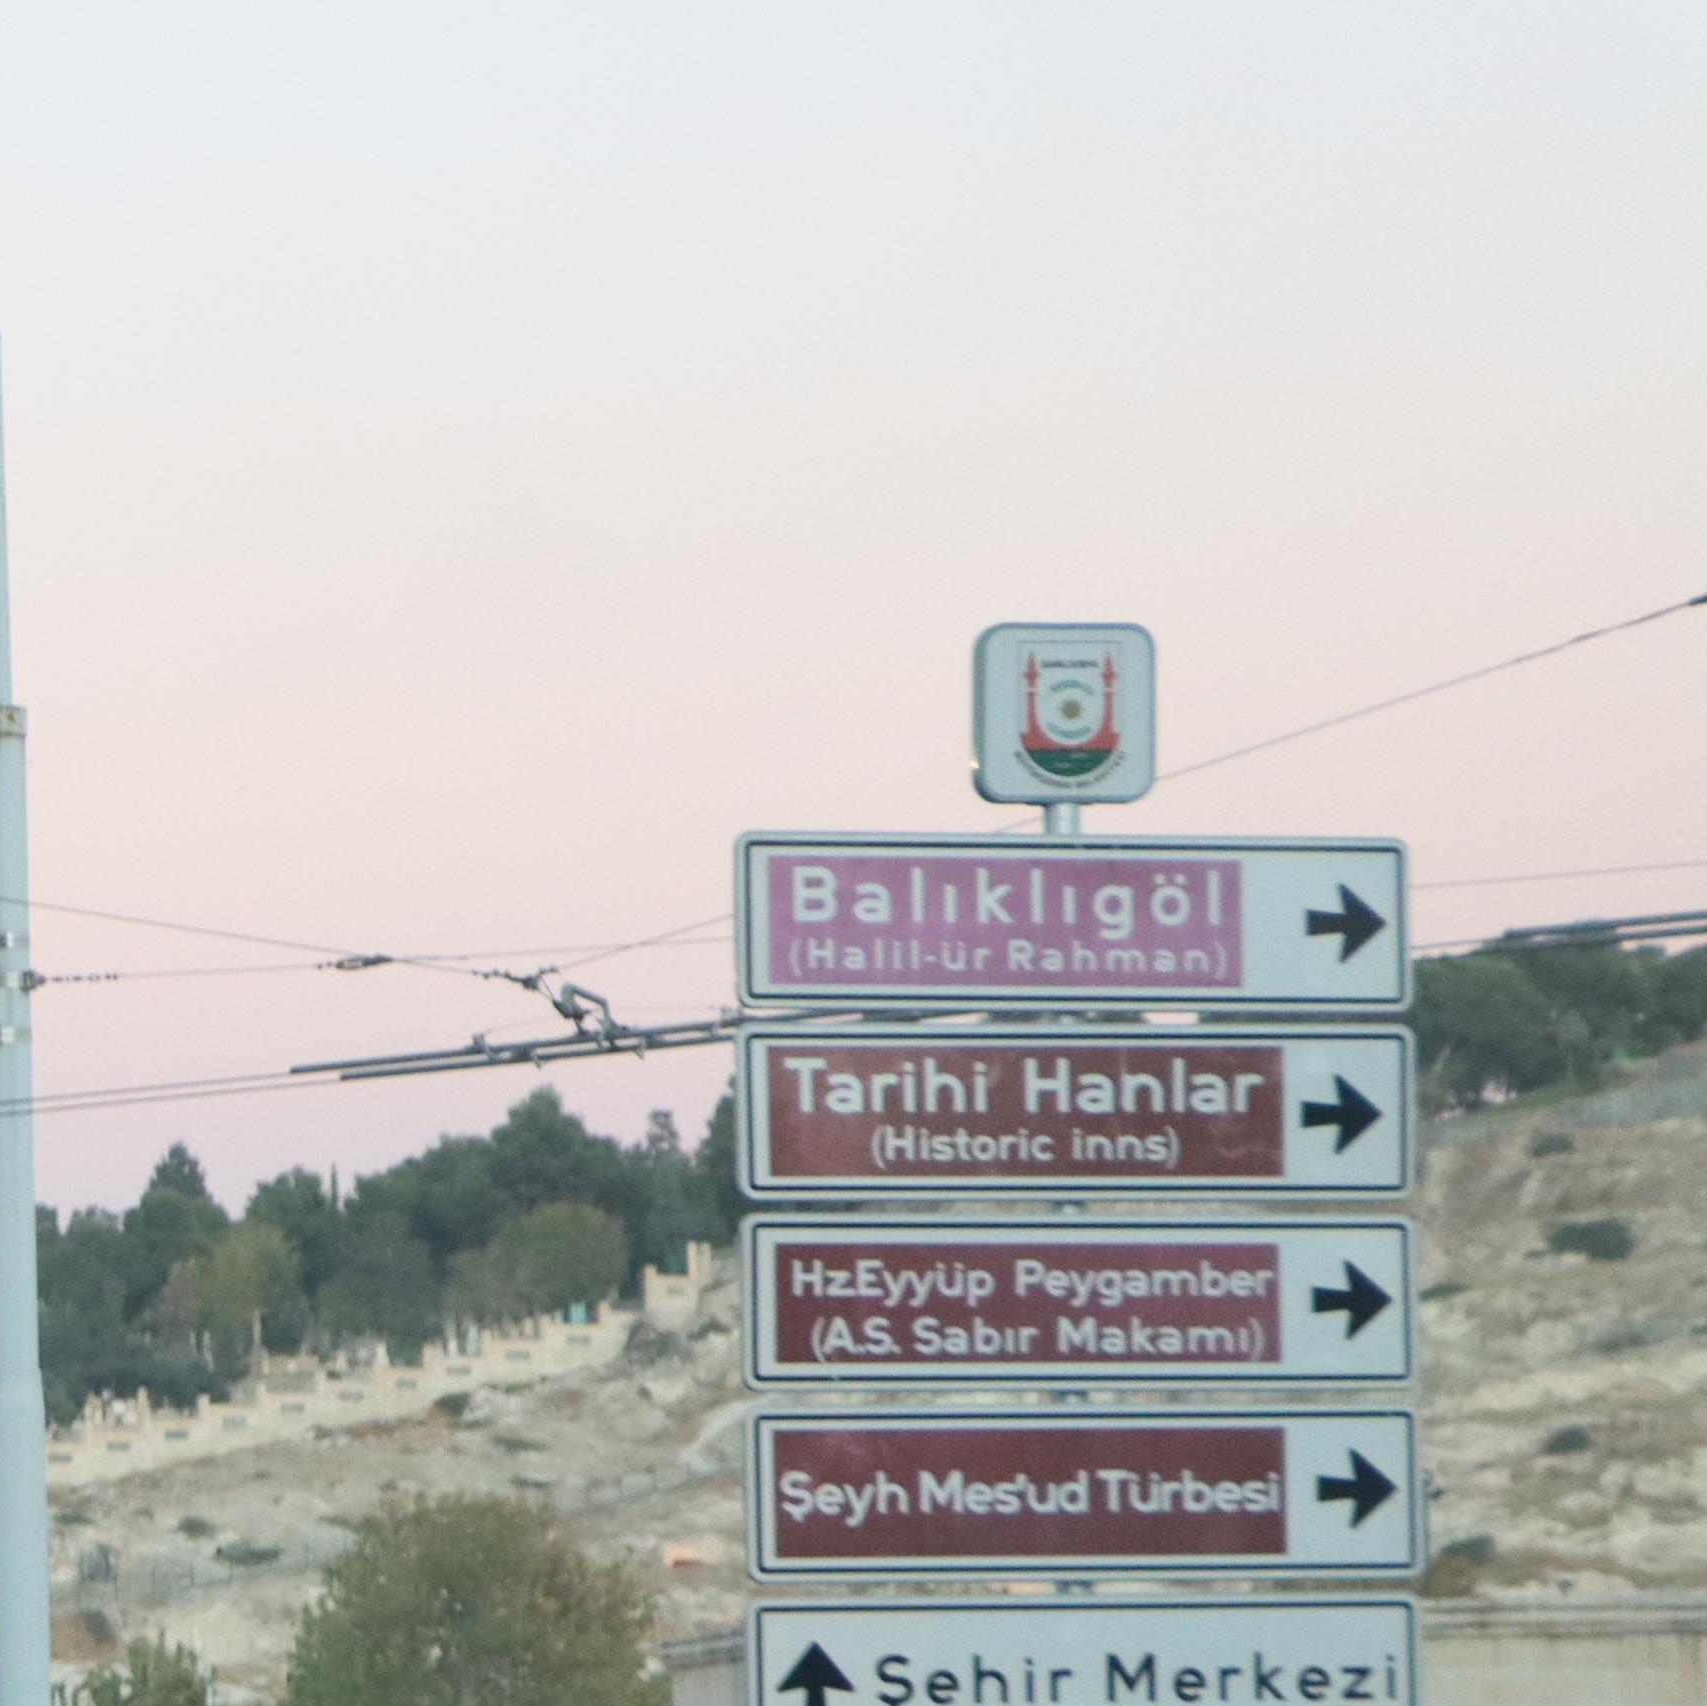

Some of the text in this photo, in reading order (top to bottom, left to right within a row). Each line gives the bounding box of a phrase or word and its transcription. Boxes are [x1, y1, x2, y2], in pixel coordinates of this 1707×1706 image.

[791, 864, 1222, 941] Balıklıgöl
[789, 937, 1228, 981] (Halil-ür Rahman)
[783, 1057, 1264, 1116] Tarihi Hanlar
[871, 1124, 1054, 1169] (Historic
[1014, 1258, 1276, 1308] Peygamber
[911, 1315, 1039, 1355] Sabır
[1057, 1315, 1265, 1362] Makamı)
[779, 1469, 909, 1528] Şeyh
[1095, 1468, 1281, 1514] Türbesi
[1105, 1653, 1397, 1703] Merkezi
